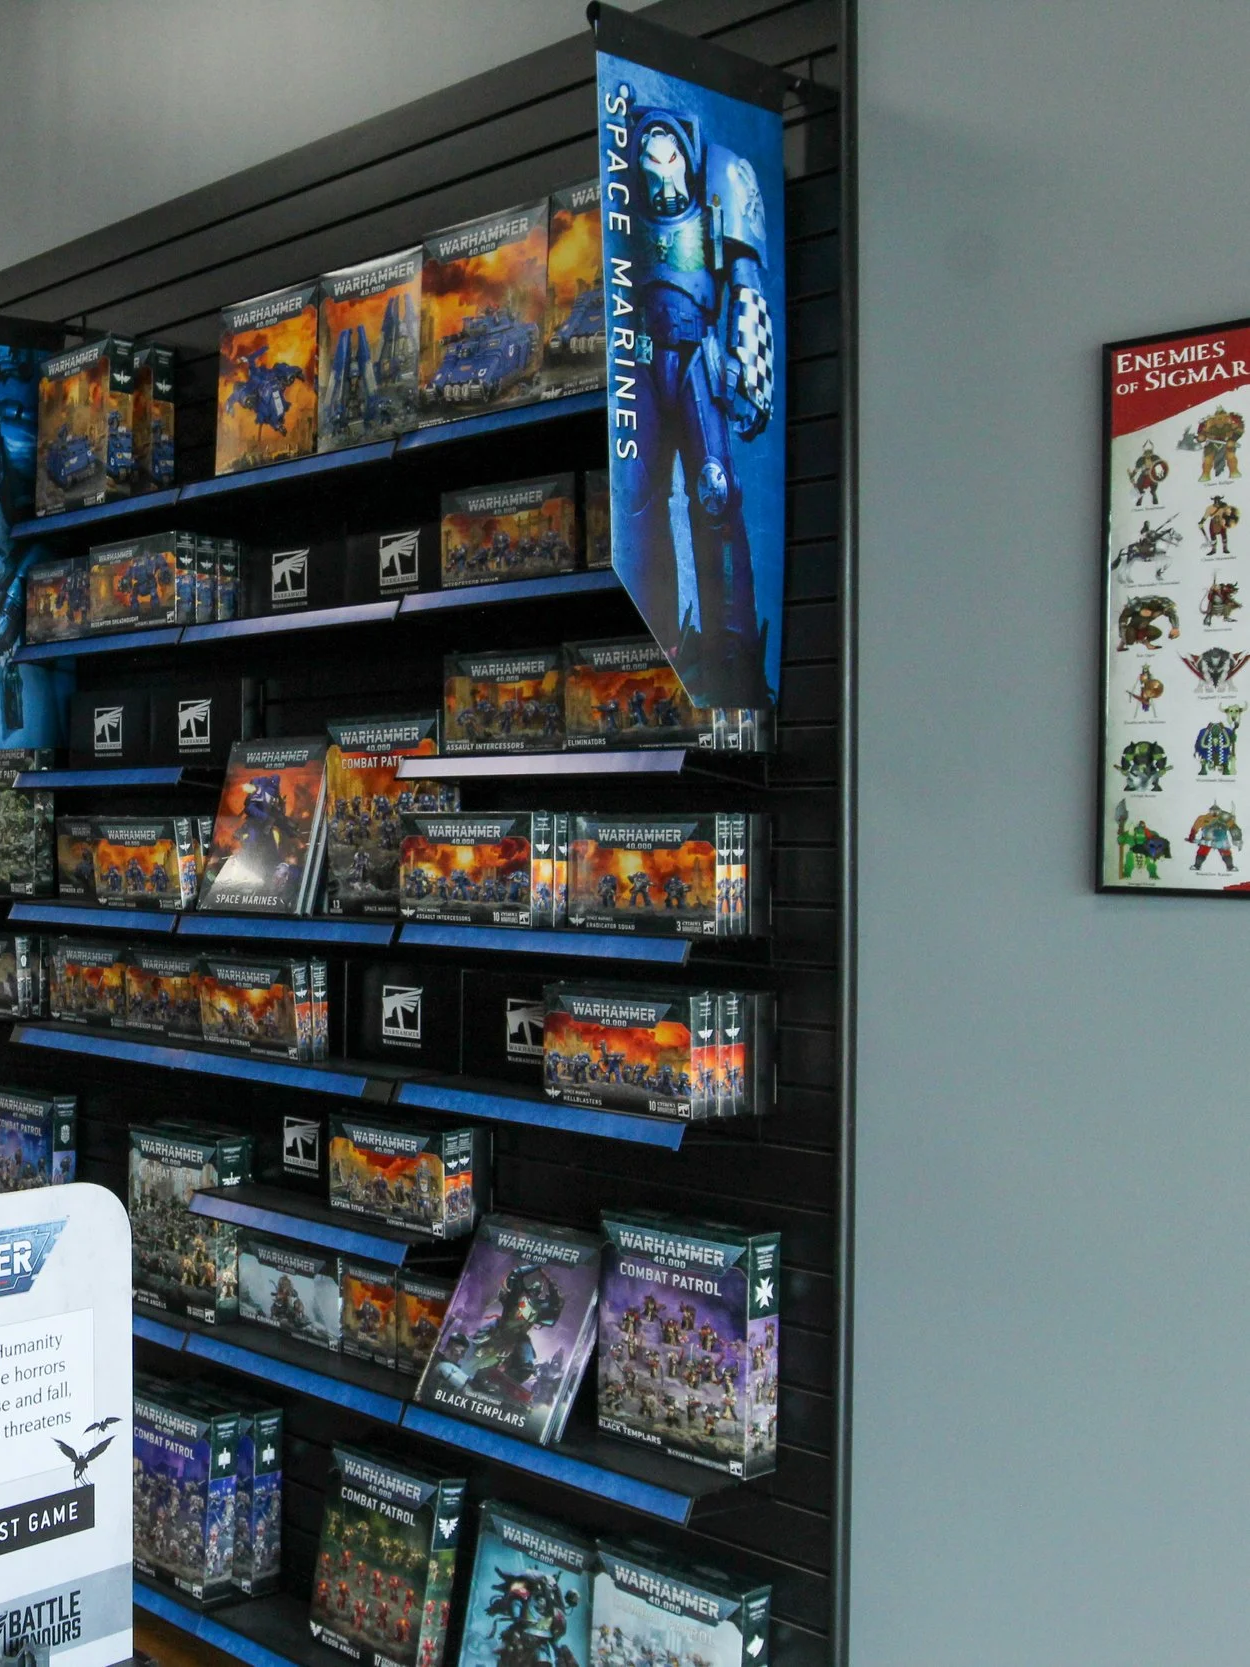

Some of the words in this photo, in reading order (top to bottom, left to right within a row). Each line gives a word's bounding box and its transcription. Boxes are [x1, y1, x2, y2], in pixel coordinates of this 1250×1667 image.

[604, 93, 631, 236] SPACE
[439, 217, 529, 257] WARHAMMER
[334, 261, 415, 296] WARHAMMER
[233, 296, 303, 328] WARHAMMER
[48, 348, 99, 376] WARHAMMER
[609, 256, 639, 461] MARINES
[1116, 341, 1226, 374] ENEMIES
[1116, 381, 1139, 396] OF
[1144, 360, 1250, 391] SIGMAR
[468, 489, 544, 514] WARHAMMER
[470, 660, 546, 677] WARHAMMER
[340, 727, 420, 746] WARHAMMER
[446, 742, 475, 751] ASSAULT
[475, 741, 525, 750] INTERCESSORS
[567, 737, 607, 746] ELIMINATORS
[246, 750, 309, 764] WARHAMMER
[341, 756, 378, 770] COMBAT
[107, 829, 157, 841] WARHAMMER
[428, 825, 501, 838] WARHAMMER
[598, 829, 682, 842] WARHAMMER
[215, 893, 239, 905] SPACE
[241, 895, 278, 906] MARINES
[333, 899, 340, 909] 13
[493, 911, 500, 922] 10
[676, 920, 681, 931] 3
[66, 950, 113, 963] WARHAMMER
[141, 959, 190, 972] WARHAMMER
[216, 969, 271, 985] WARHAMMER
[572, 1001, 656, 1022] WARHAMMER
[563, 1094, 602, 1106] HELLBLASTERS
[649, 1101, 656, 1112] 10
[20, 1122, 43, 1137] PATROL
[352, 1130, 418, 1153] WARHAMMER
[140, 1139, 204, 1165] WARHAMMER
[330, 1199, 350, 1209] CAPTAIN
[351, 1202, 364, 1213] TITUS
[258, 1248, 315, 1273] WARHAMMER
[498, 1233, 581, 1264] WARHAMMER
[619, 1231, 725, 1267] WARHAMMER
[619, 1262, 669, 1285] COMBAT
[672, 1273, 723, 1297] PATROL
[14, 1359, 66, 1383] horrors
[15, 1390, 43, 1409] and
[47, 1382, 73, 1401] fall,
[134, 1402, 198, 1438] WARHAMMER
[434, 1389, 467, 1409] BLACK
[470, 1399, 526, 1428] TEMPLARS
[3, 1410, 73, 1440] threatens
[599, 1418, 621, 1433] BLACK
[622, 1423, 662, 1445] TEMPLARS
[133, 1426, 163, 1448] COMBAT
[165, 1437, 195, 1461] PATROL
[344, 1459, 422, 1502] WARHAMMER
[28, 1501, 79, 1532] GAME
[341, 1486, 379, 1511] COMBAT
[380, 1501, 416, 1527] PATROL
[502, 1524, 584, 1569] WARHAMMER
[614, 1564, 720, 1619] WARHAMMER
[9, 1590, 82, 1638] BATTLE
[9, 1617, 82, 1651] HONOURS
[321, 1634, 339, 1649] BLOOD
[339, 1643, 361, 1660] ANGELS
[374, 1653, 381, 1666] 17
